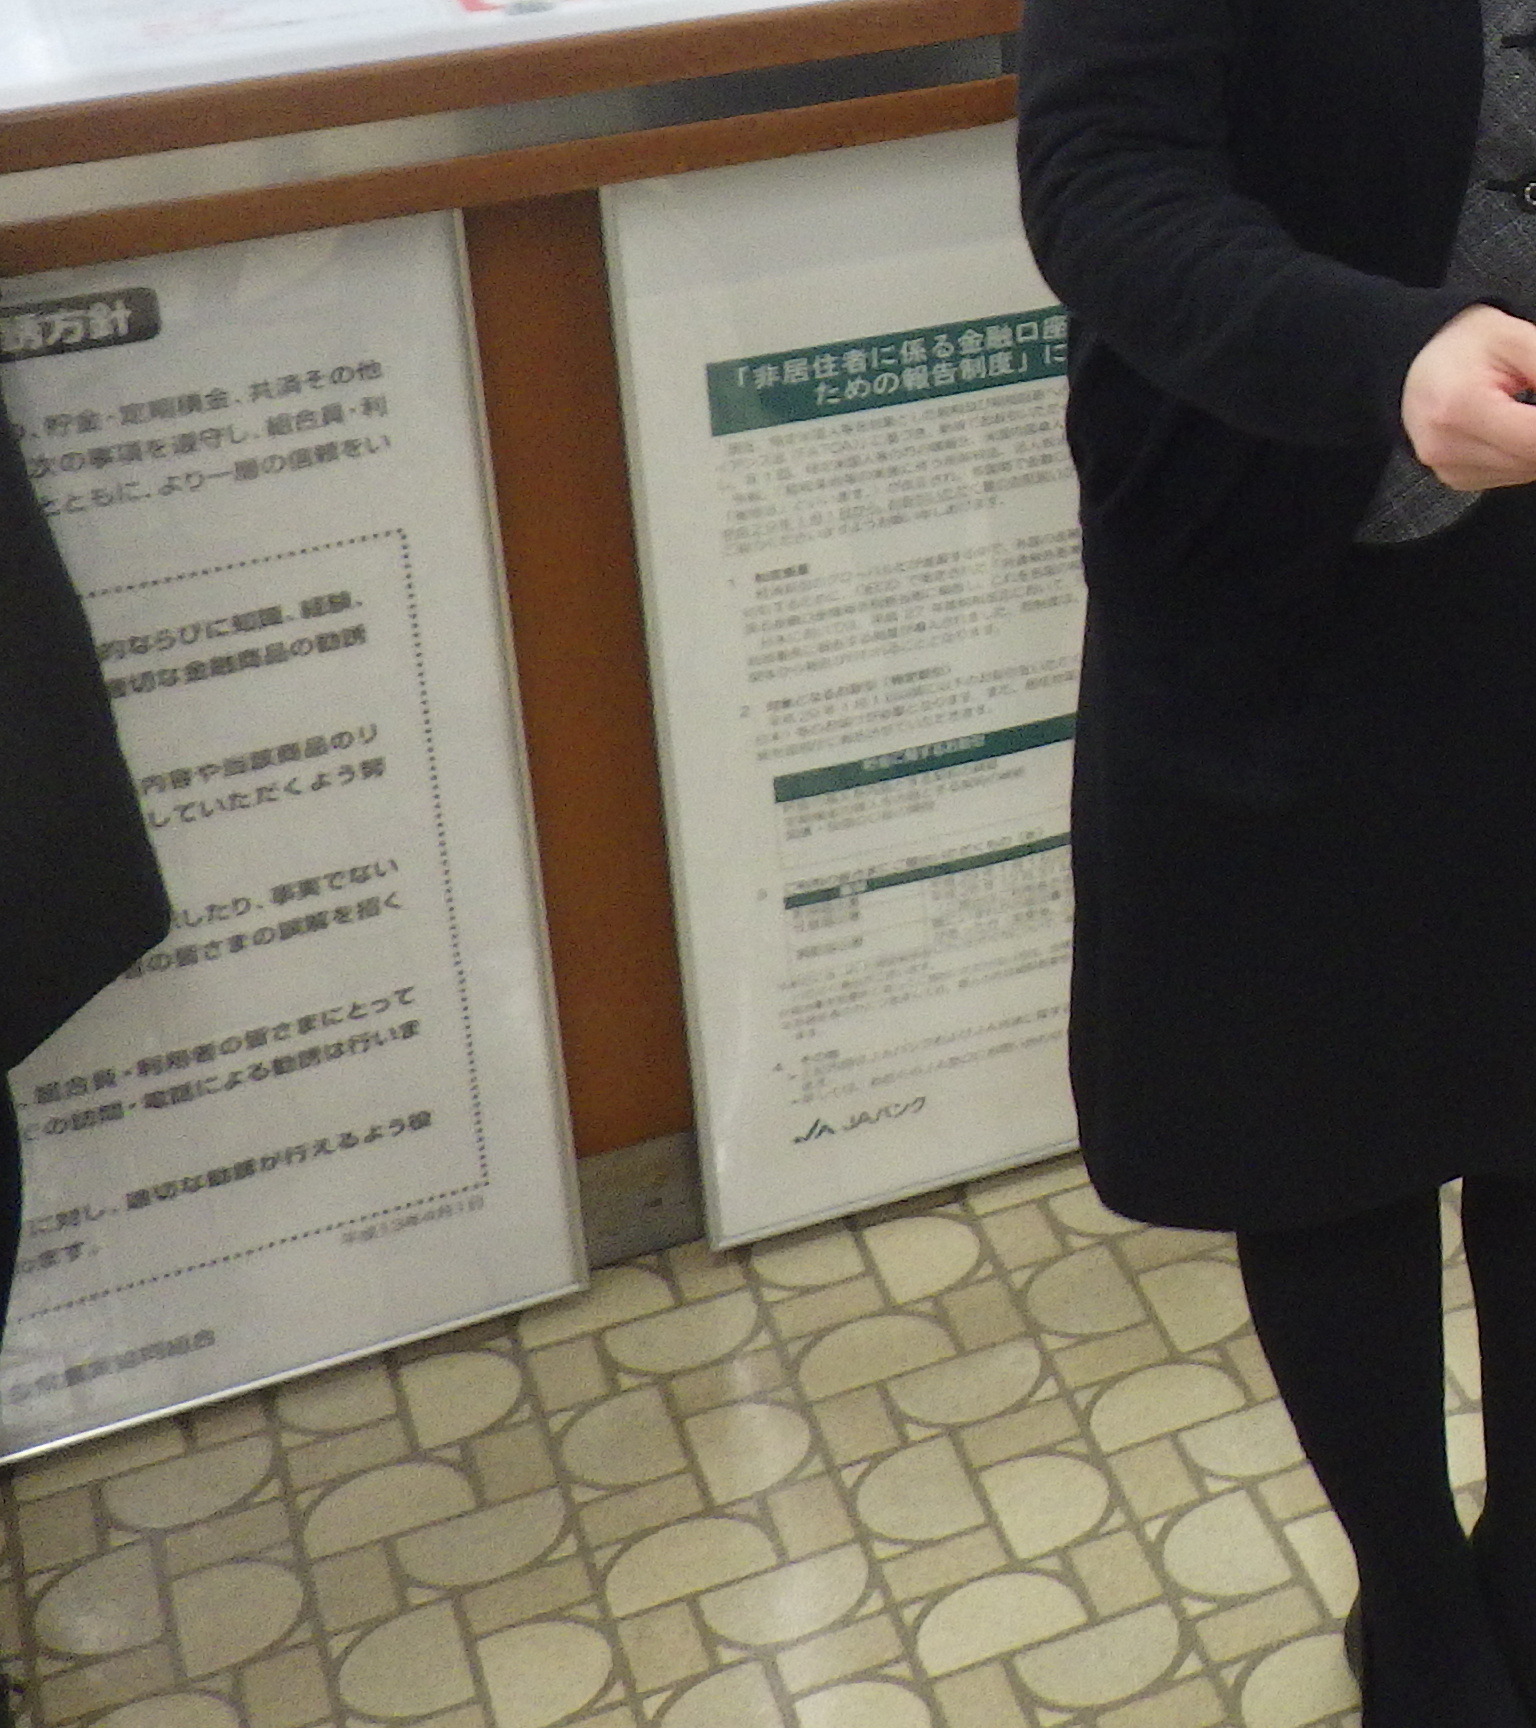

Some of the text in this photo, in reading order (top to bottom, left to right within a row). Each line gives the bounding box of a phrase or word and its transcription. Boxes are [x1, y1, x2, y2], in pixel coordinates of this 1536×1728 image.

[173, 858, 398, 930] したり、事実でない
